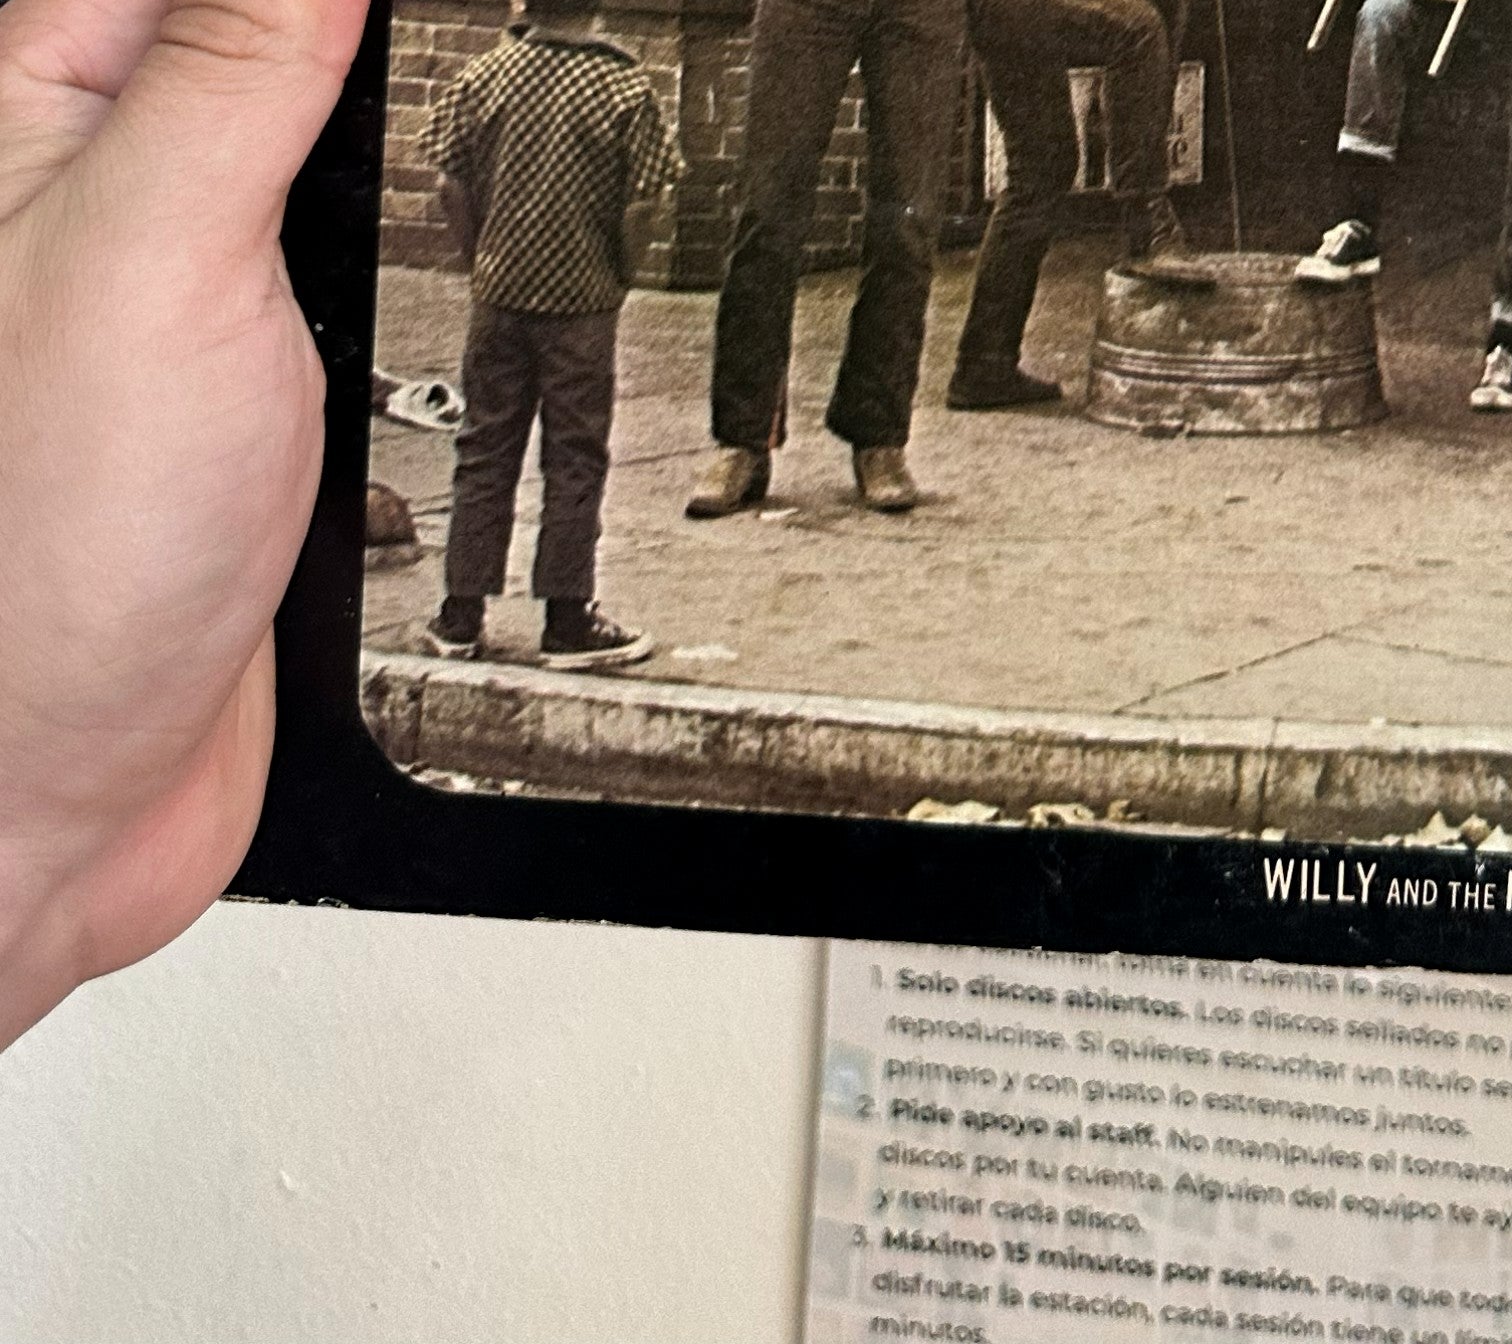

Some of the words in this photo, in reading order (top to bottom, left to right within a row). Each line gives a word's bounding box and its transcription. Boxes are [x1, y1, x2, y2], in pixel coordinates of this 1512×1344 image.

[1262, 857, 1377, 904] WILLY
[1386, 877, 1438, 906] AND
[1448, 880, 1497, 910] THE
[896, 967, 959, 993] Solo
[965, 974, 1057, 1003] discos
[1195, 998, 1244, 1025] Los
[1250, 1006, 1338, 1033] discos
[1346, 1017, 1459, 1047] sellados
[1466, 1034, 1505, 1054] no
[884, 1057, 998, 1086] primero
[1002, 1070, 1020, 1092] y
[1024, 1073, 1078, 1096] con
[1081, 1079, 1166, 1102] gusto
[1169, 1083, 1198, 1106] lo
[1202, 1091, 1370, 1125] estrenamos
[1075, 1030, 1103, 1054] Si
[1107, 1035, 1212, 1065] quieres
[1218, 1049, 1345, 1080] escuchar
[1353, 1064, 1394, 1082] un
[888, 1097, 955, 1124] Pide
[960, 1109, 1048, 1136] apoyo
[1054, 1114, 1081, 1139] al
[1166, 1128, 1210, 1151] No
[1213, 1137, 1364, 1169] manipules
[1368, 1148, 1397, 1171] el
[878, 1141, 966, 1169] discos
[972, 1154, 1017, 1177] por
[1026, 1158, 1058, 1180] tu
[1173, 1172, 1286, 1204] Alguien
[1290, 1185, 1336, 1209] del
[1342, 1193, 1442, 1223] equipo
[1448, 1202, 1478, 1225] te
[899, 1189, 984, 1215] retirar
[989, 1199, 1058, 1224] cada
[881, 1226, 996, 1259] Máximo
[1002, 1240, 1030, 1263] 15
[1036, 1245, 1155, 1277] minutos
[1162, 1262, 1213, 1285] por
[1326, 1275, 1392, 1301] Para
[1396, 1285, 1454, 1309] que
[872, 1270, 990, 1303] disfrutar
[998, 1281, 1024, 1307] la
[1160, 1303, 1228, 1328] cada
[1233, 1312, 1324, 1339] sesión
[1330, 1317, 1404, 1342] tiene
